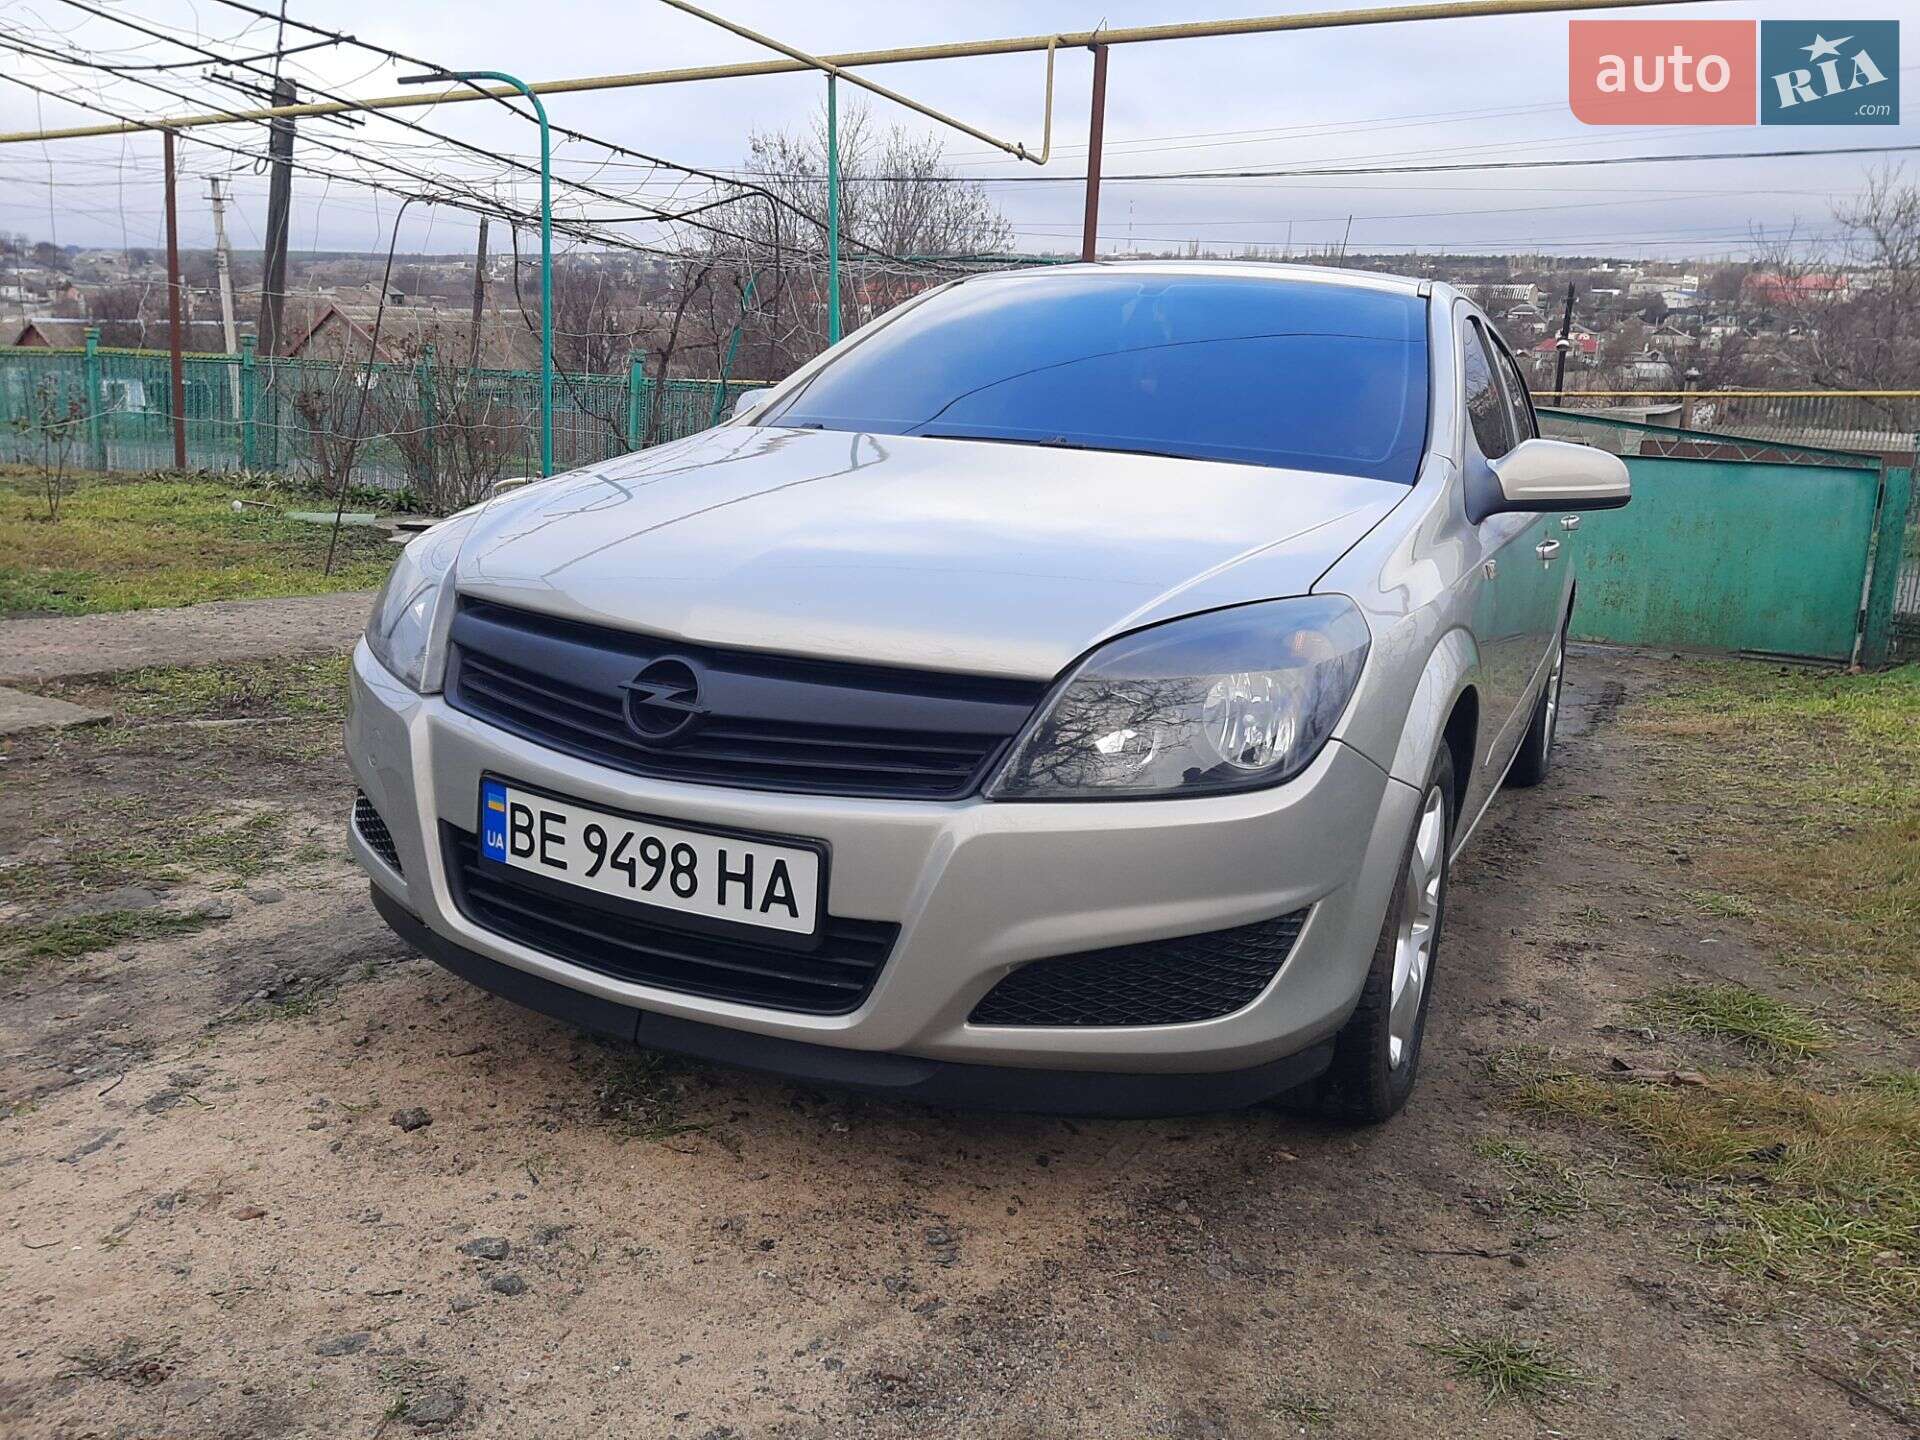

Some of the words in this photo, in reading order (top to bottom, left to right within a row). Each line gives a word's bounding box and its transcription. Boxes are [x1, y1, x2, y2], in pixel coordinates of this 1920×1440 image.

[487, 830, 505, 850] UA
[509, 802, 568, 870] BE
[582, 823, 698, 898] 9498
[717, 849, 799, 918] HA
